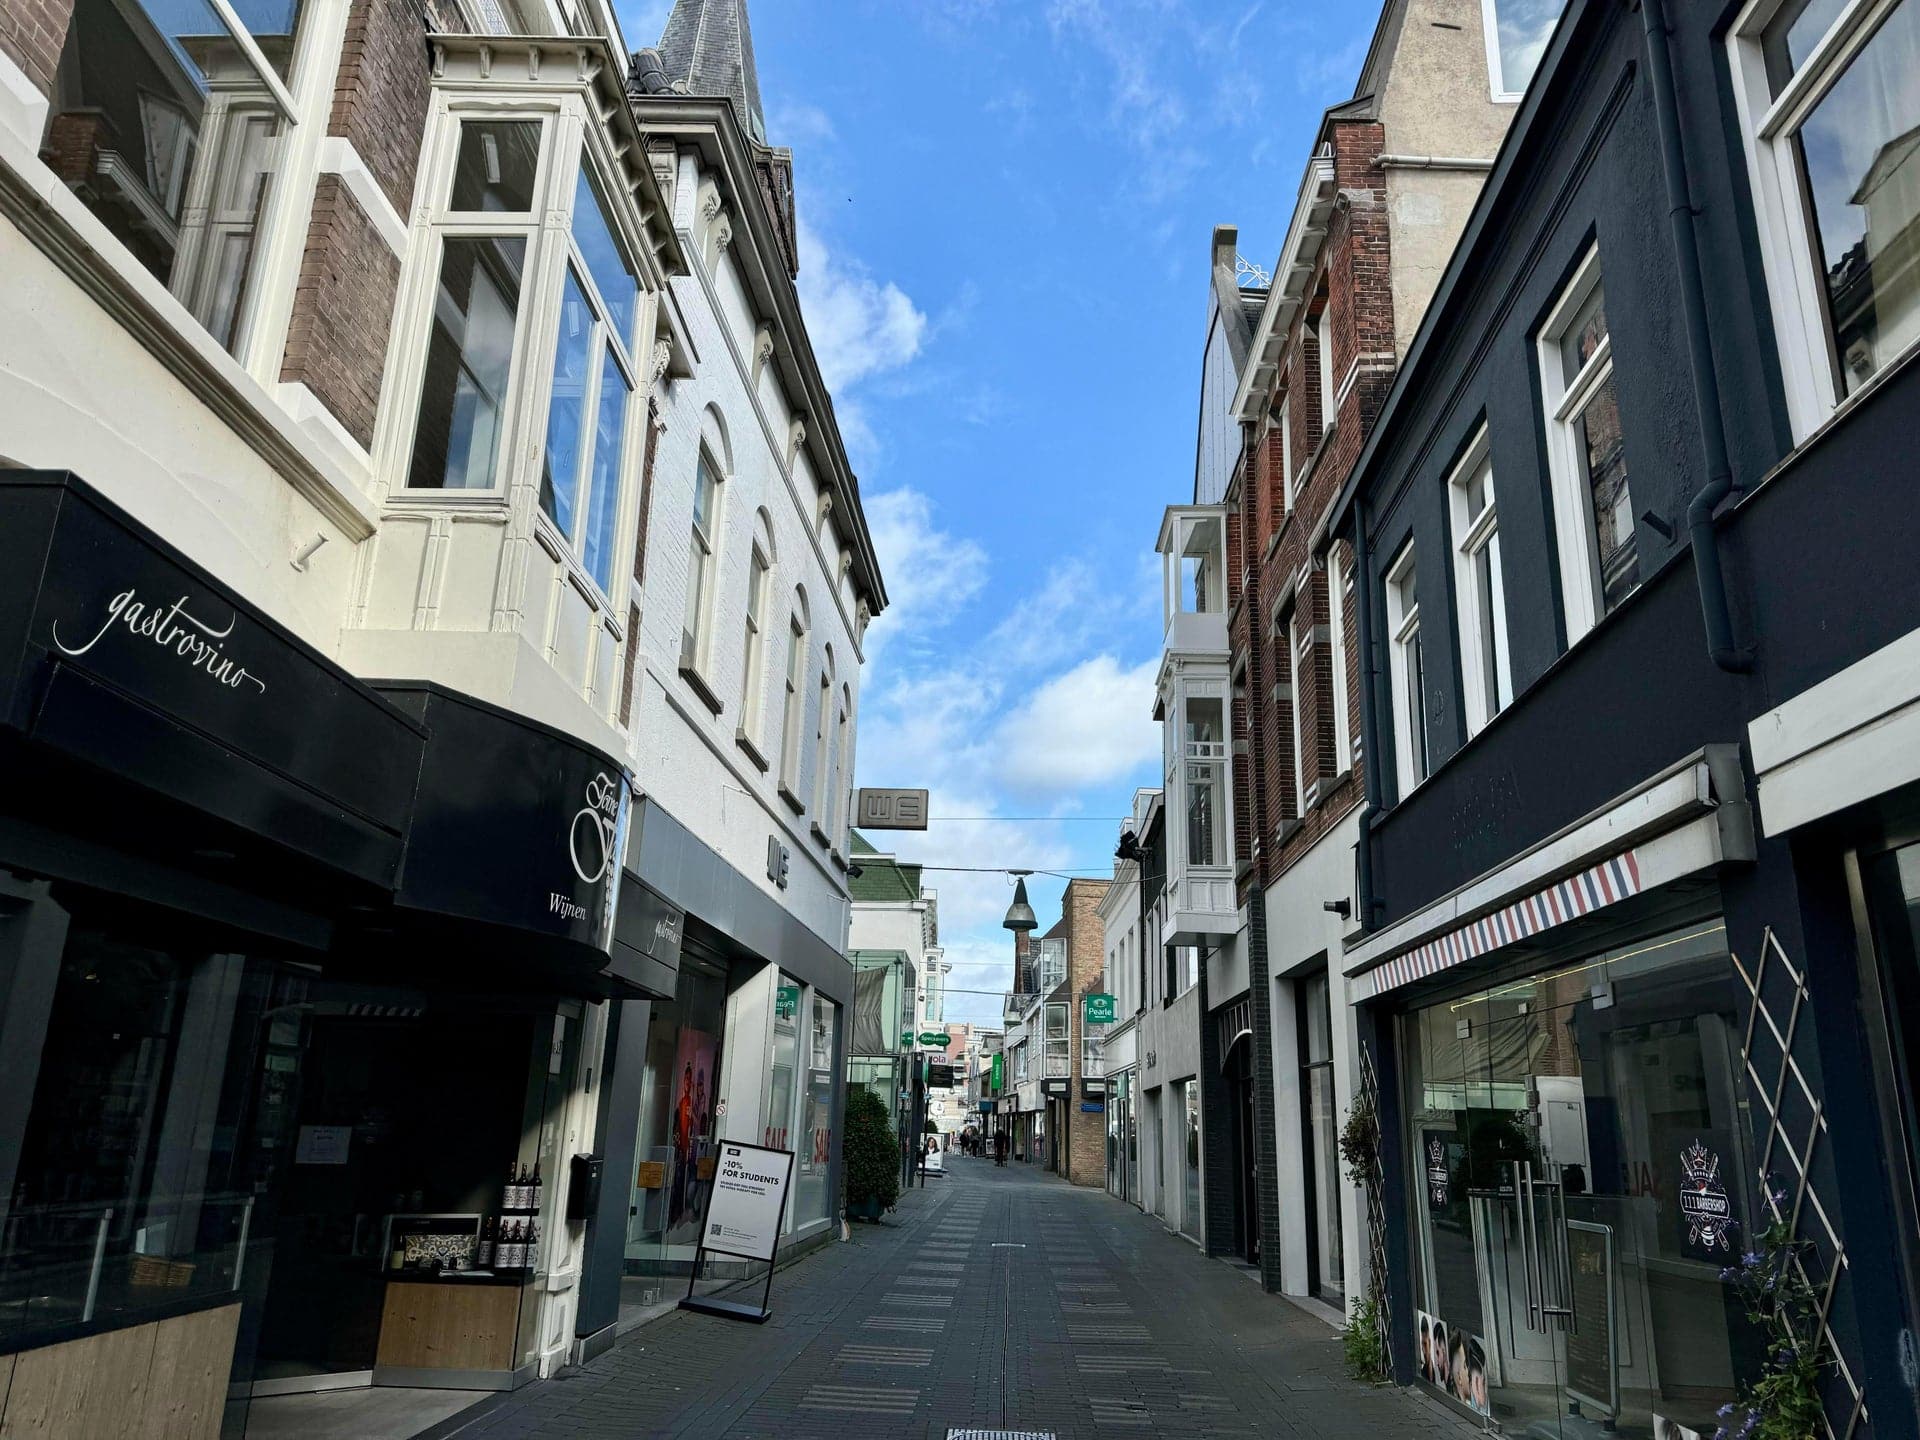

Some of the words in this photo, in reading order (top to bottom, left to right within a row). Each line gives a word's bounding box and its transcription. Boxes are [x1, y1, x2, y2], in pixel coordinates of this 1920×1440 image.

[53, 589, 265, 694] gastrovino
[868, 796, 919, 820] WE
[549, 892, 586, 921] Wijnen
[1088, 1007, 1112, 1016] Pearle
[724, 1160, 743, 1170] -10%
[722, 1168, 738, 1179] FOR
[739, 1172, 780, 1186] STUDENTS
